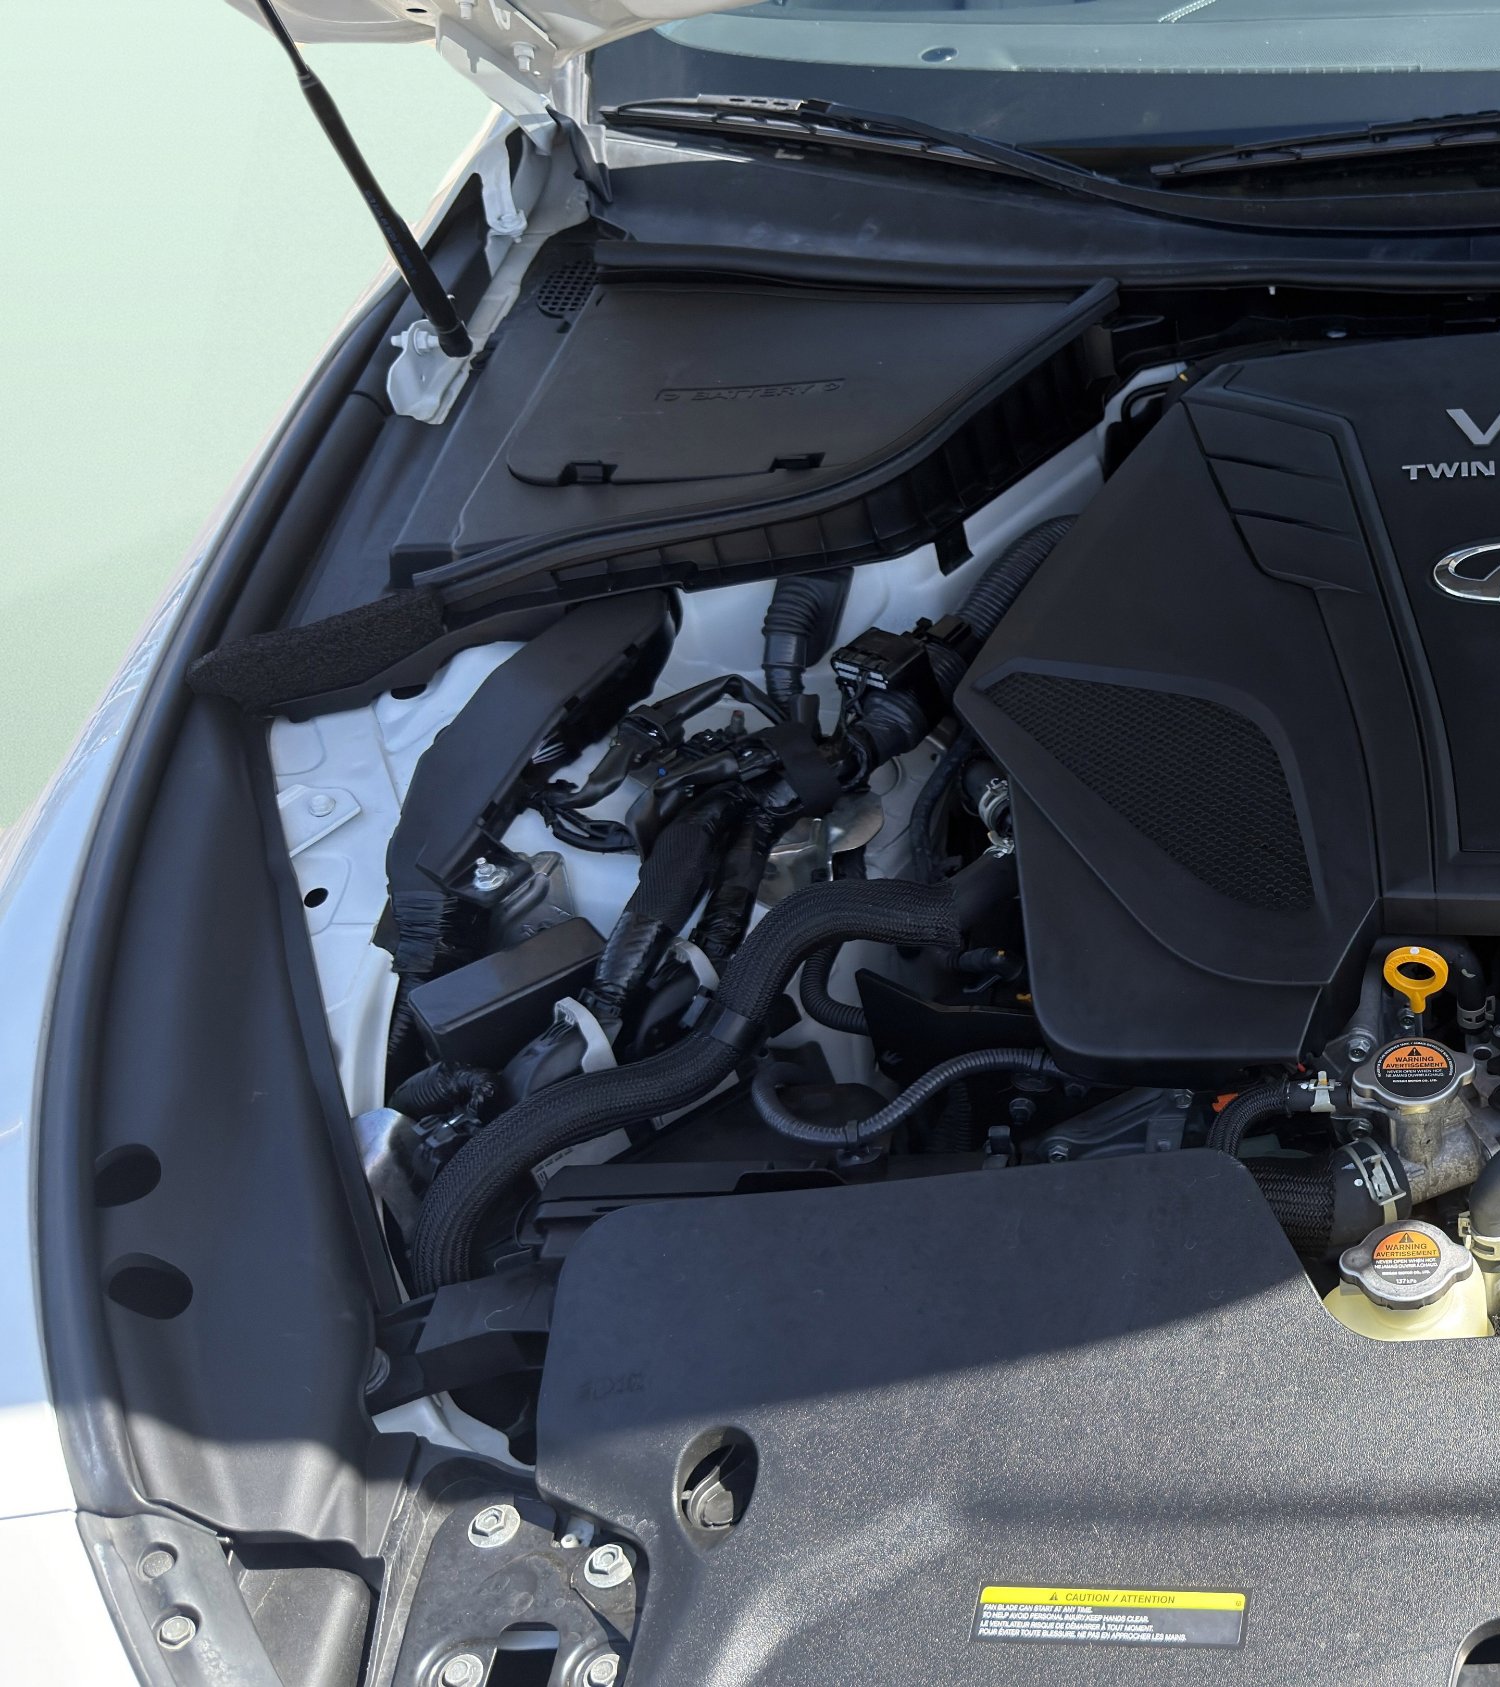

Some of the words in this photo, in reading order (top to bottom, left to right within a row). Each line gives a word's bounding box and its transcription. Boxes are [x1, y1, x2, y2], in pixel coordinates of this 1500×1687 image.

[1402, 460, 1496, 480] TWIN
[1065, 1593, 1110, 1602] CAUTION
[1120, 1594, 1175, 1604] ATTENTION
[989, 1620, 1030, 1628] VENTILATEUR
[1030, 1621, 1054, 1629] RISQUE
[978, 1628, 998, 1636] POUR
[1020, 1629, 1041, 1637] TOUTE
[1077, 1631, 1087, 1639] NE
[1111, 1632, 1151, 1640] APPROCHER
